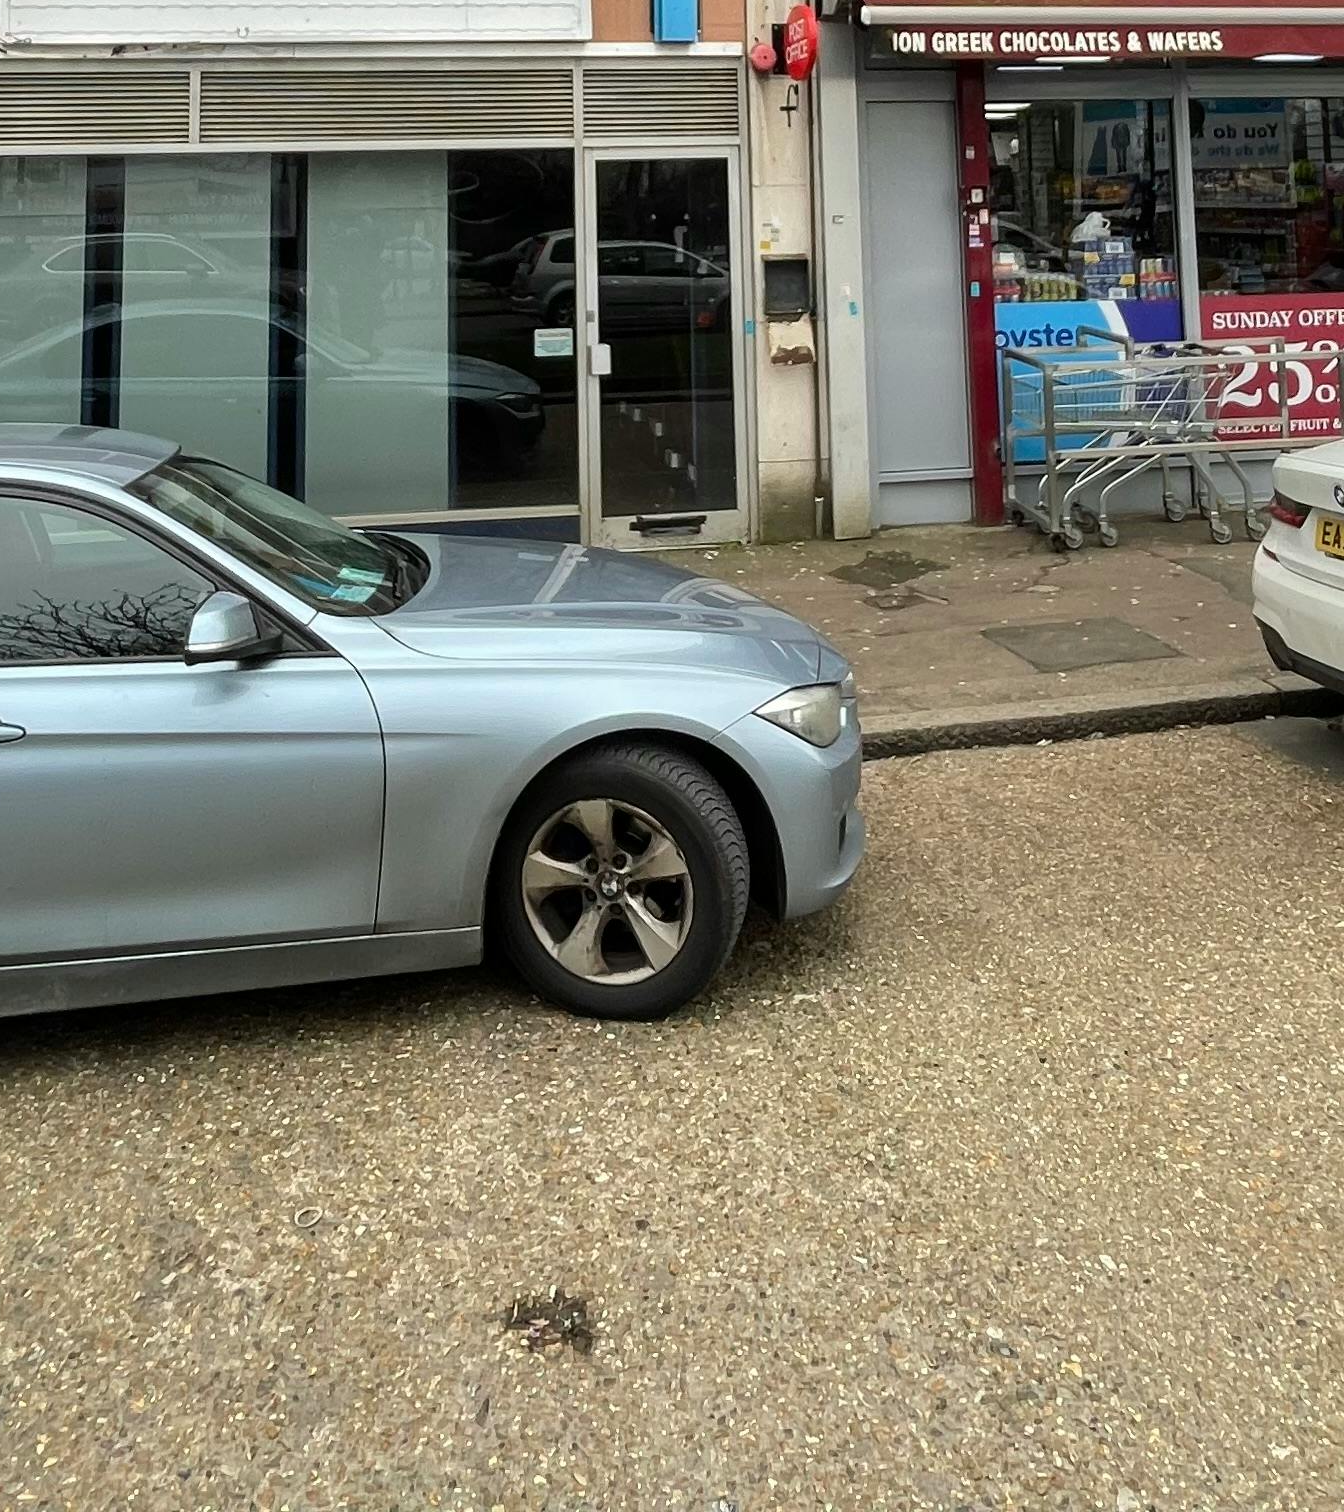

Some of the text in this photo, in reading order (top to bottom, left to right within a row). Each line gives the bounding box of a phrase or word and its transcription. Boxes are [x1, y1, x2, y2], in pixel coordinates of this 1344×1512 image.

[892, 30, 1224, 54] ION GREEK CHOCOLATES & WAFERS
[1212, 310, 1294, 330] SUNDAY
[995, 323, 1077, 349] oyste
[1289, 417, 1331, 432] FRUIT
[1332, 416, 1342, 430] &
